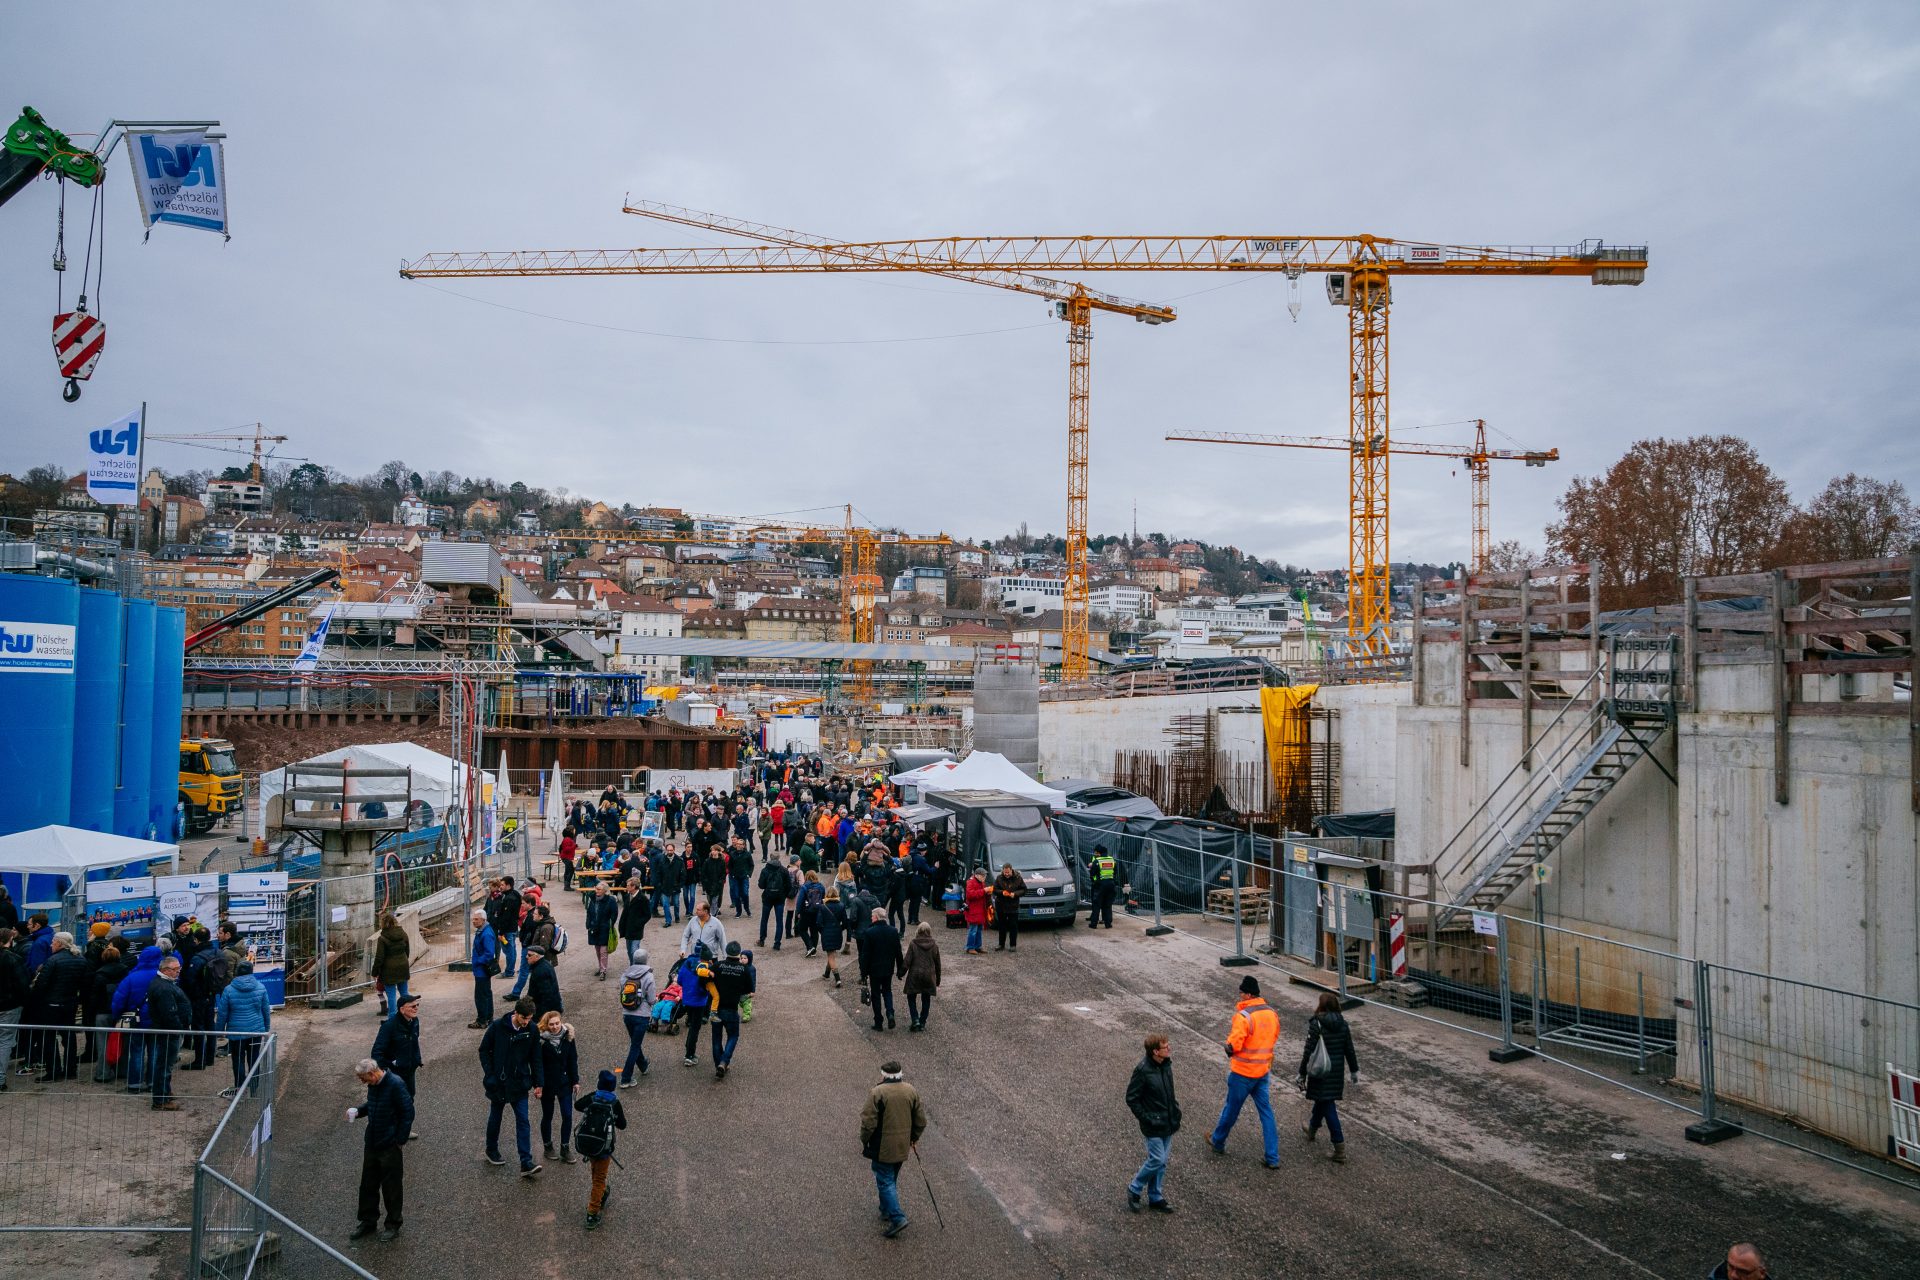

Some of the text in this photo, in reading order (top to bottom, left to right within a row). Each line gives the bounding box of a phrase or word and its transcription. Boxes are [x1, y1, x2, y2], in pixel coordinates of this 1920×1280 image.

[1254, 241, 1298, 251] WOLFF
[36, 634, 68, 645] hölscher
[36, 645, 74, 656] wasserbau
[163, 902, 191, 910] AUSSICHT!
